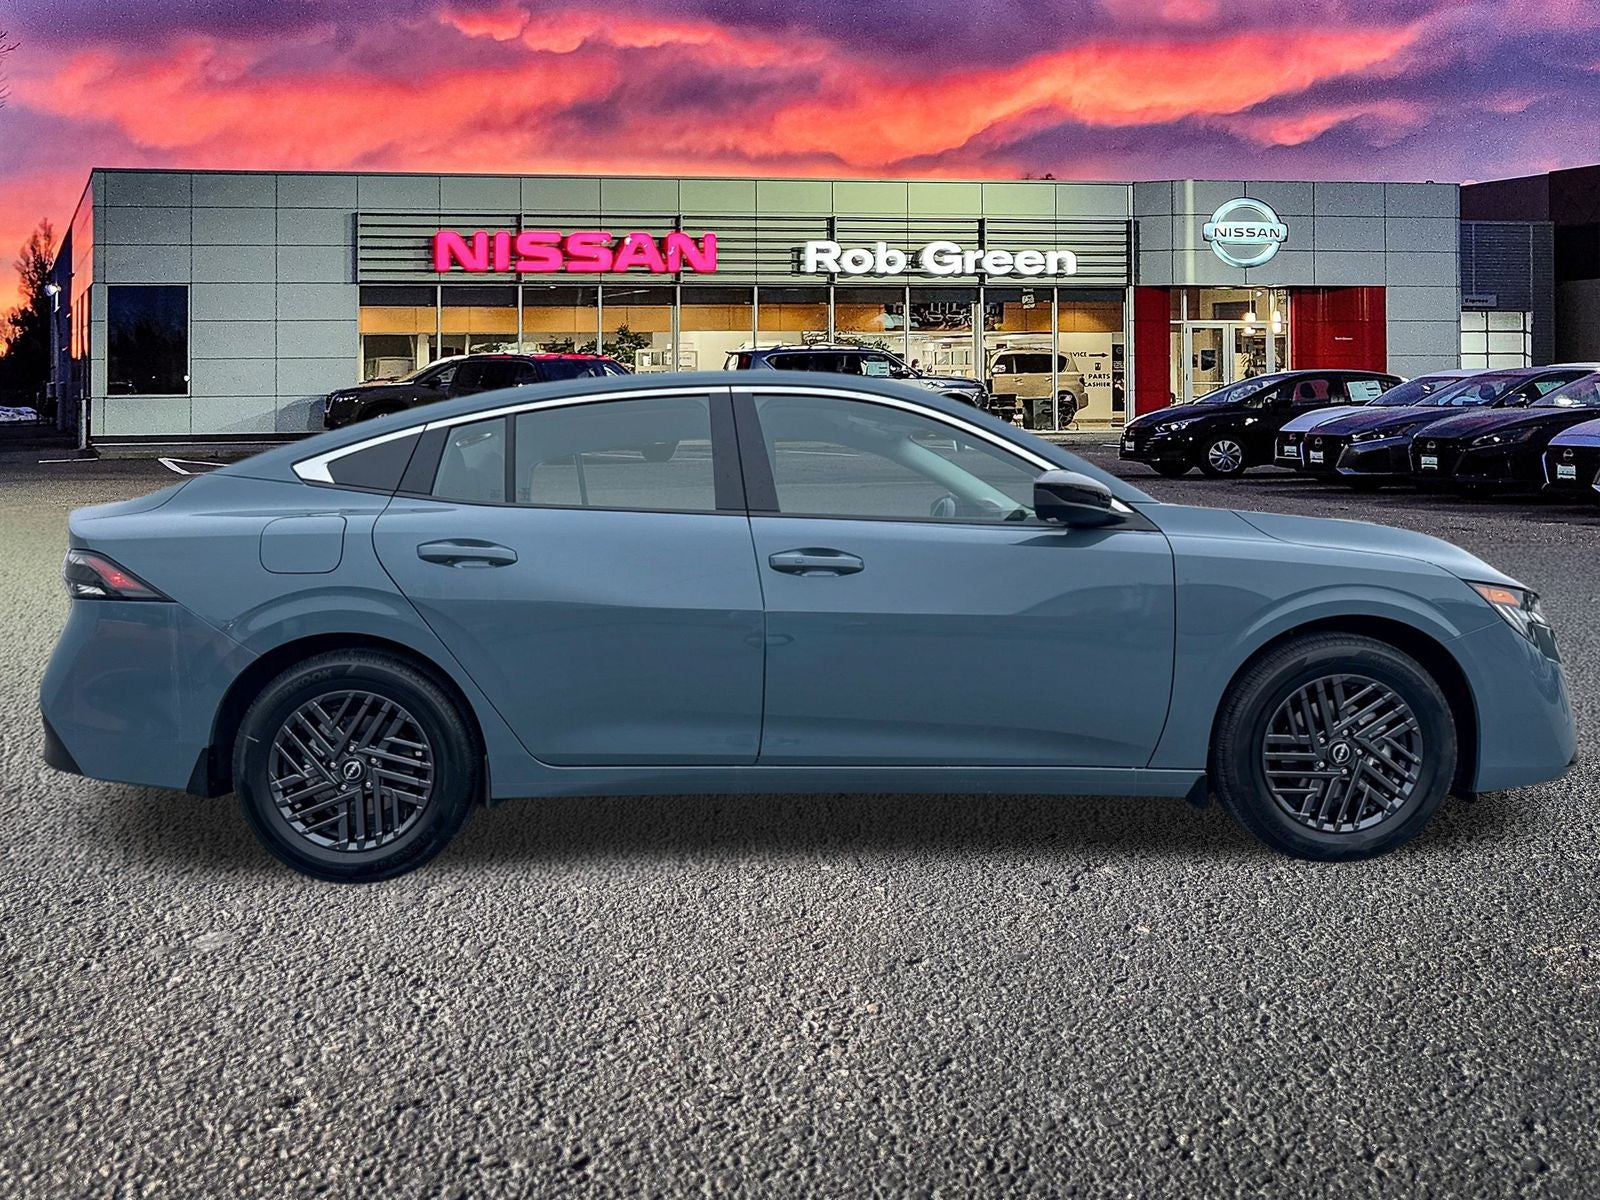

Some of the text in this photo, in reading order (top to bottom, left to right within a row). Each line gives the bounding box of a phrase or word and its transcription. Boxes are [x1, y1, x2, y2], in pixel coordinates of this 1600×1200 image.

[1214, 227, 1280, 238] NISSAN
[434, 230, 718, 273] NISSAN
[804, 240, 1078, 276] Rob Green
